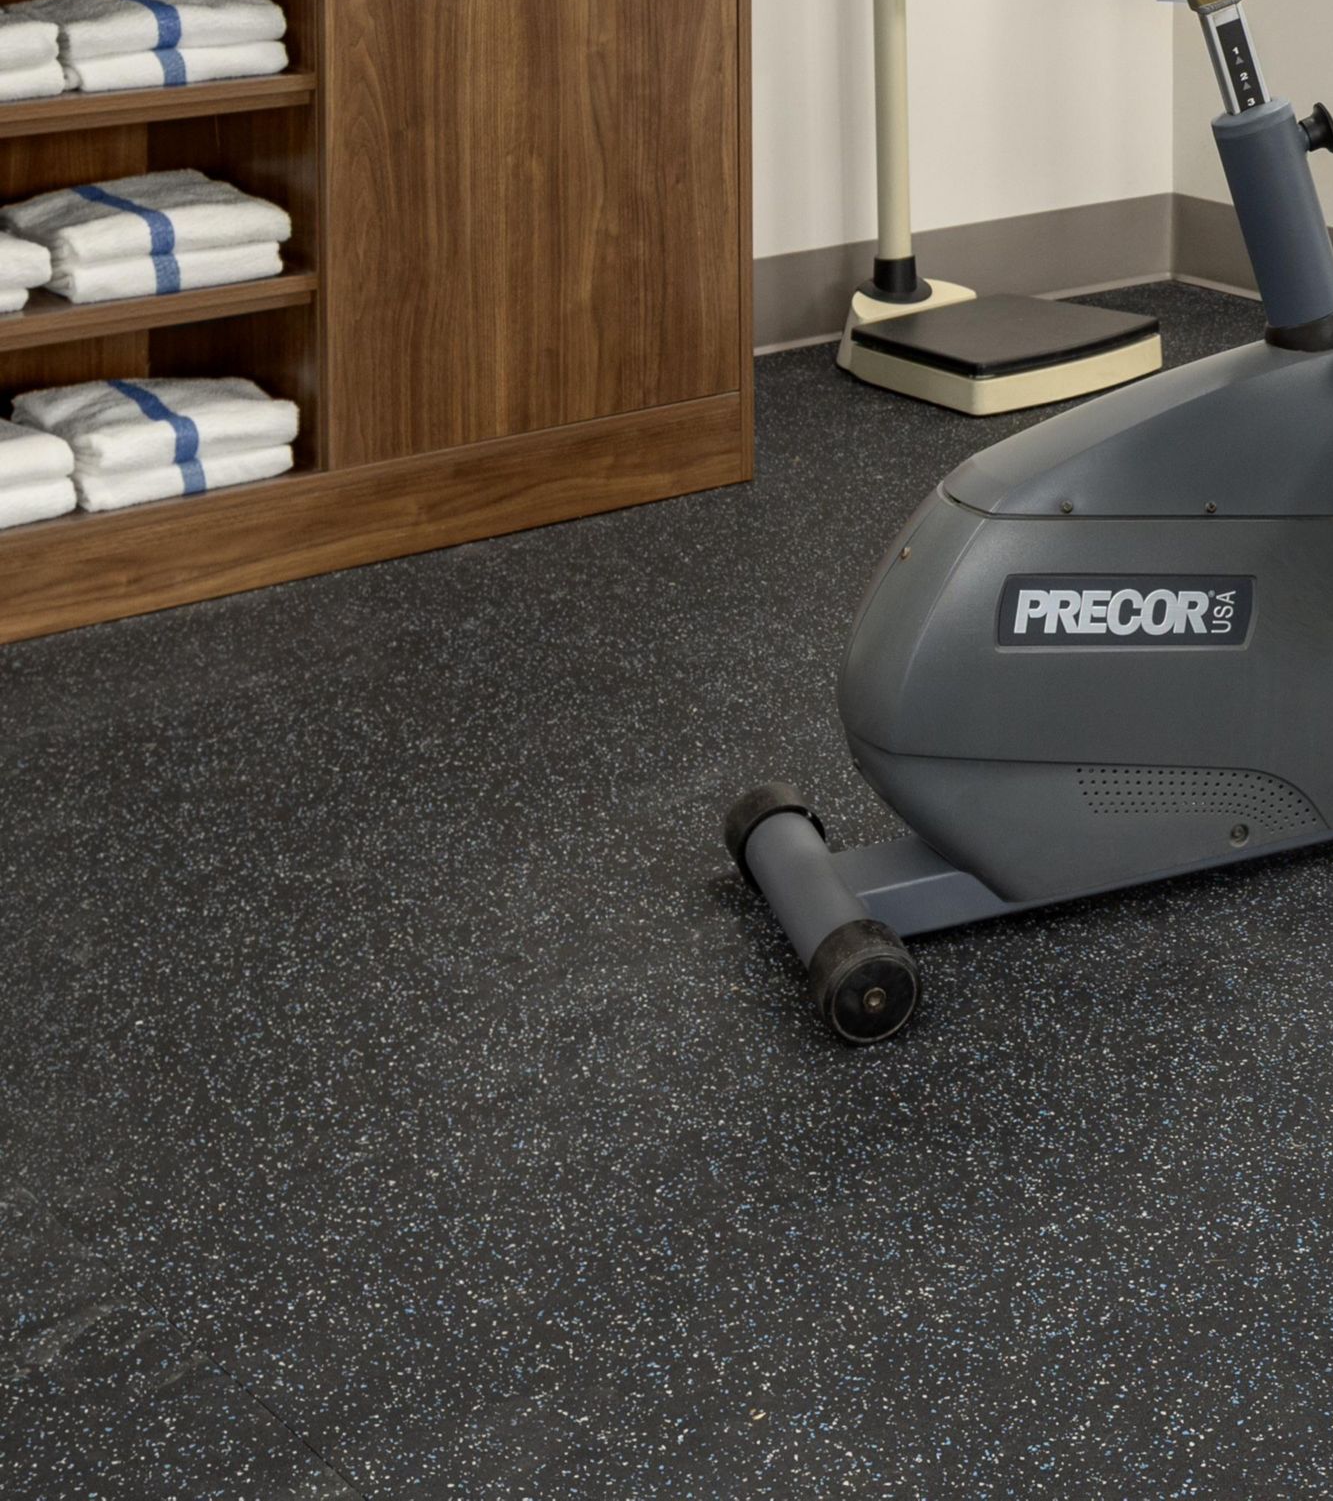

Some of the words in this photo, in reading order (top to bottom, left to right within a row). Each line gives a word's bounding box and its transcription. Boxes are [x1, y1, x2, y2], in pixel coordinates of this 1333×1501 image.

[1231, 46, 1240, 55] 1
[1239, 72, 1249, 81] 2
[1247, 97, 1256, 107] 3
[1013, 588, 1209, 636] PRECOR
[1210, 590, 1237, 634] USA
